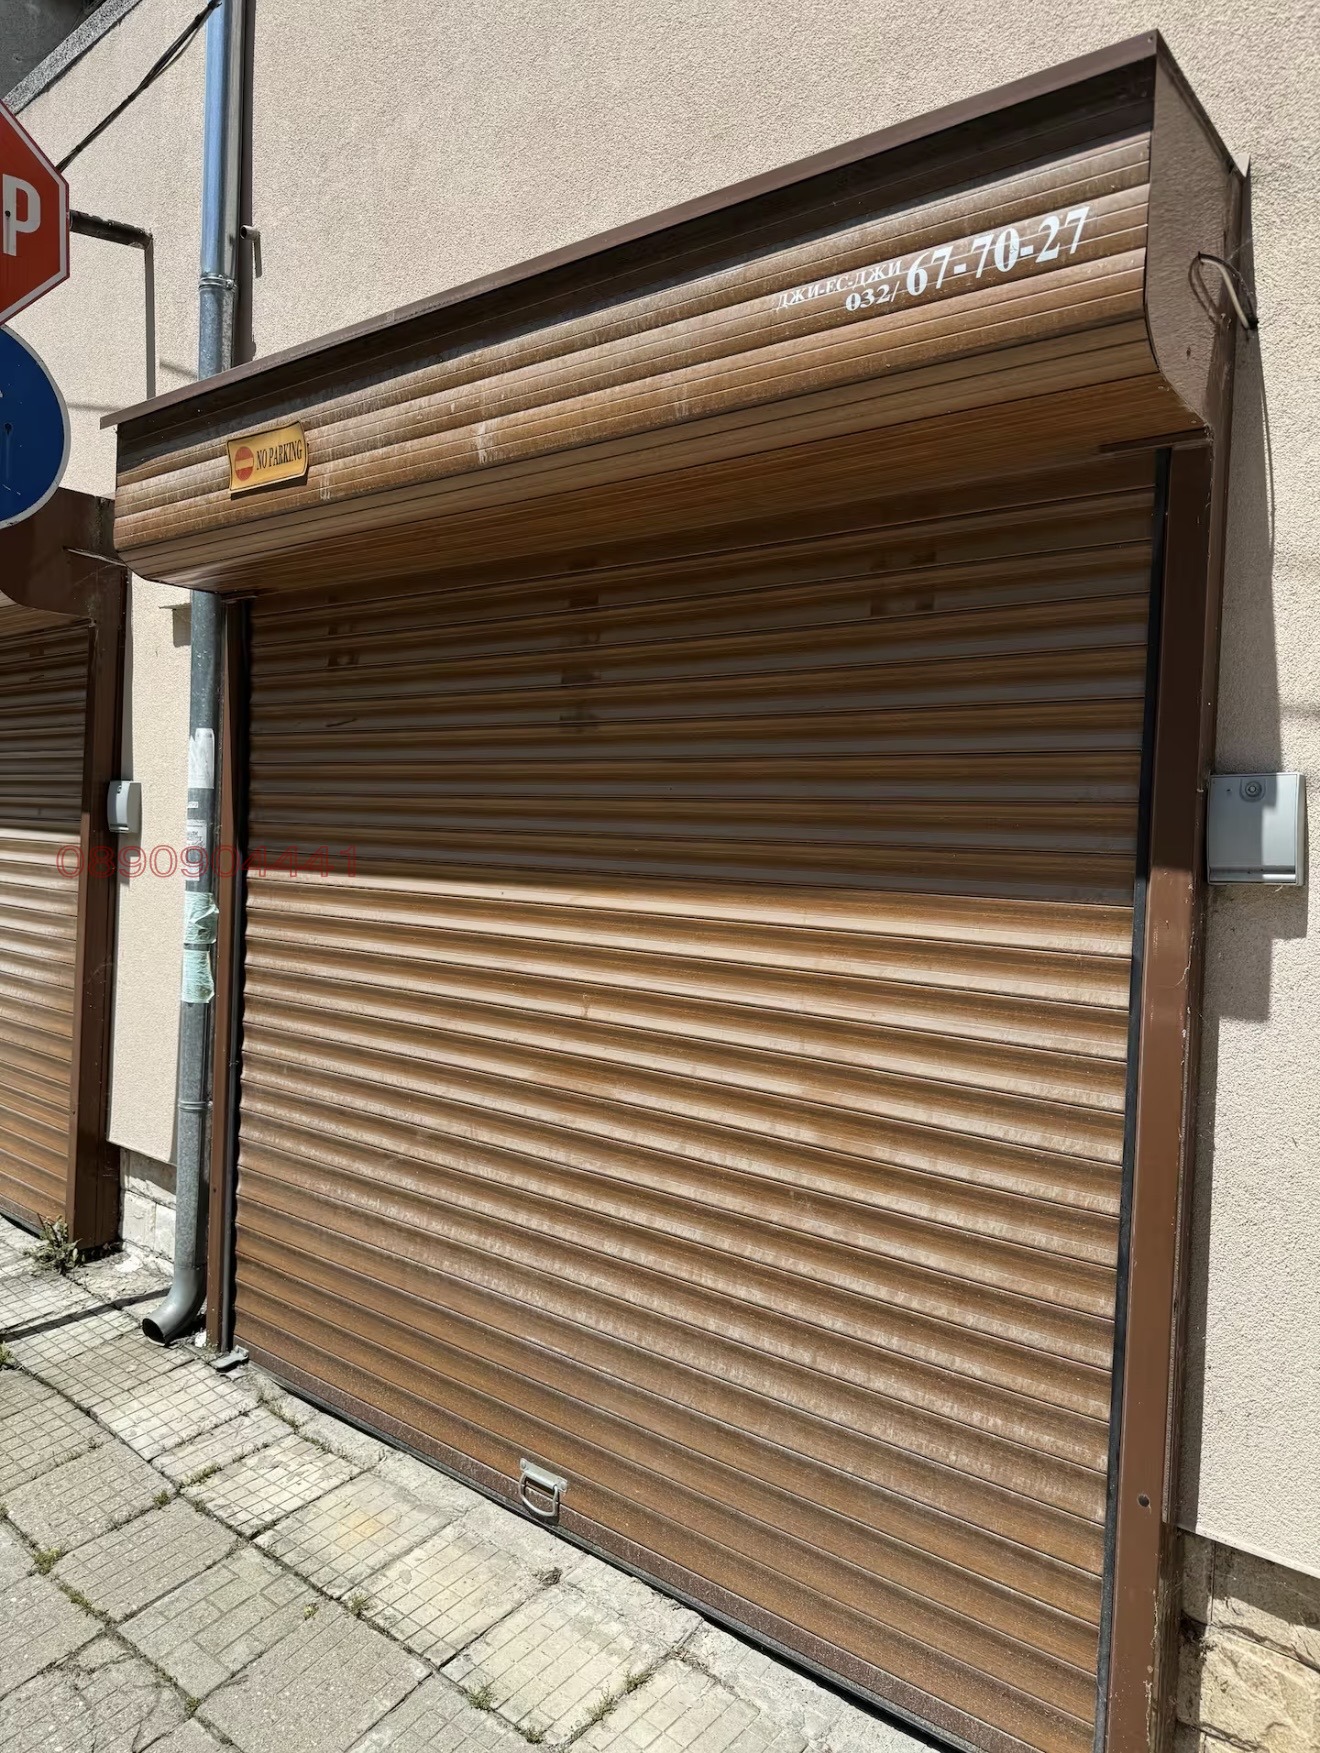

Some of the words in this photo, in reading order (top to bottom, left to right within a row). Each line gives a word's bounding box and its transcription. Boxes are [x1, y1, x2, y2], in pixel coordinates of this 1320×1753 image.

[776, 259, 902, 311] ДЖИ-ЕС-ДЖИ
[256, 449, 267, 470] NO
[269, 440, 303, 467] PARKING
